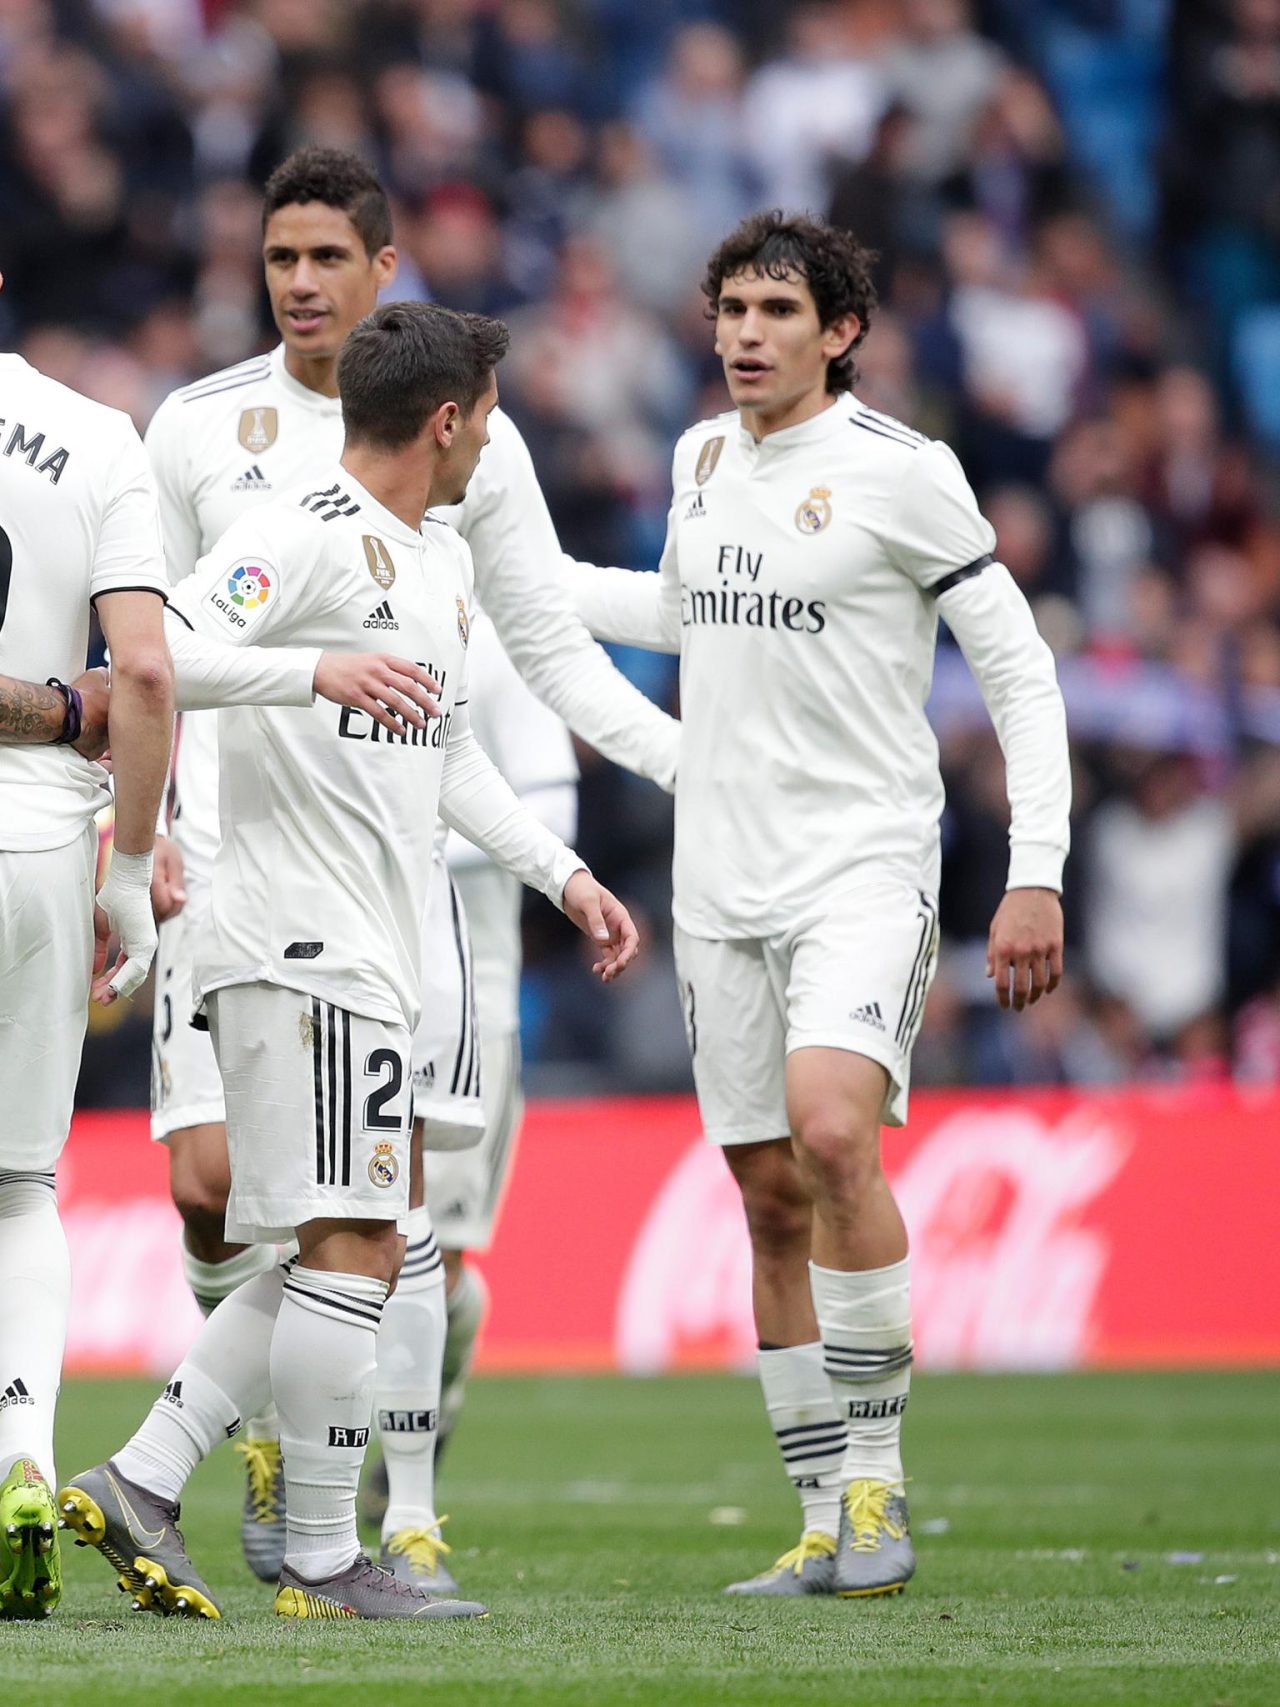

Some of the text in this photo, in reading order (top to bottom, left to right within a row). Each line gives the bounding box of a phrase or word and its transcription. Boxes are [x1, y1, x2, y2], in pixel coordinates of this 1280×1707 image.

[718, 546, 762, 581] Fly
[211, 593, 246, 628] LaLiga
[362, 618, 400, 631] adidas
[681, 580, 826, 634] Emirates
[363, 1048, 413, 1133] 2
[0, 1396, 35, 1411] adidas
